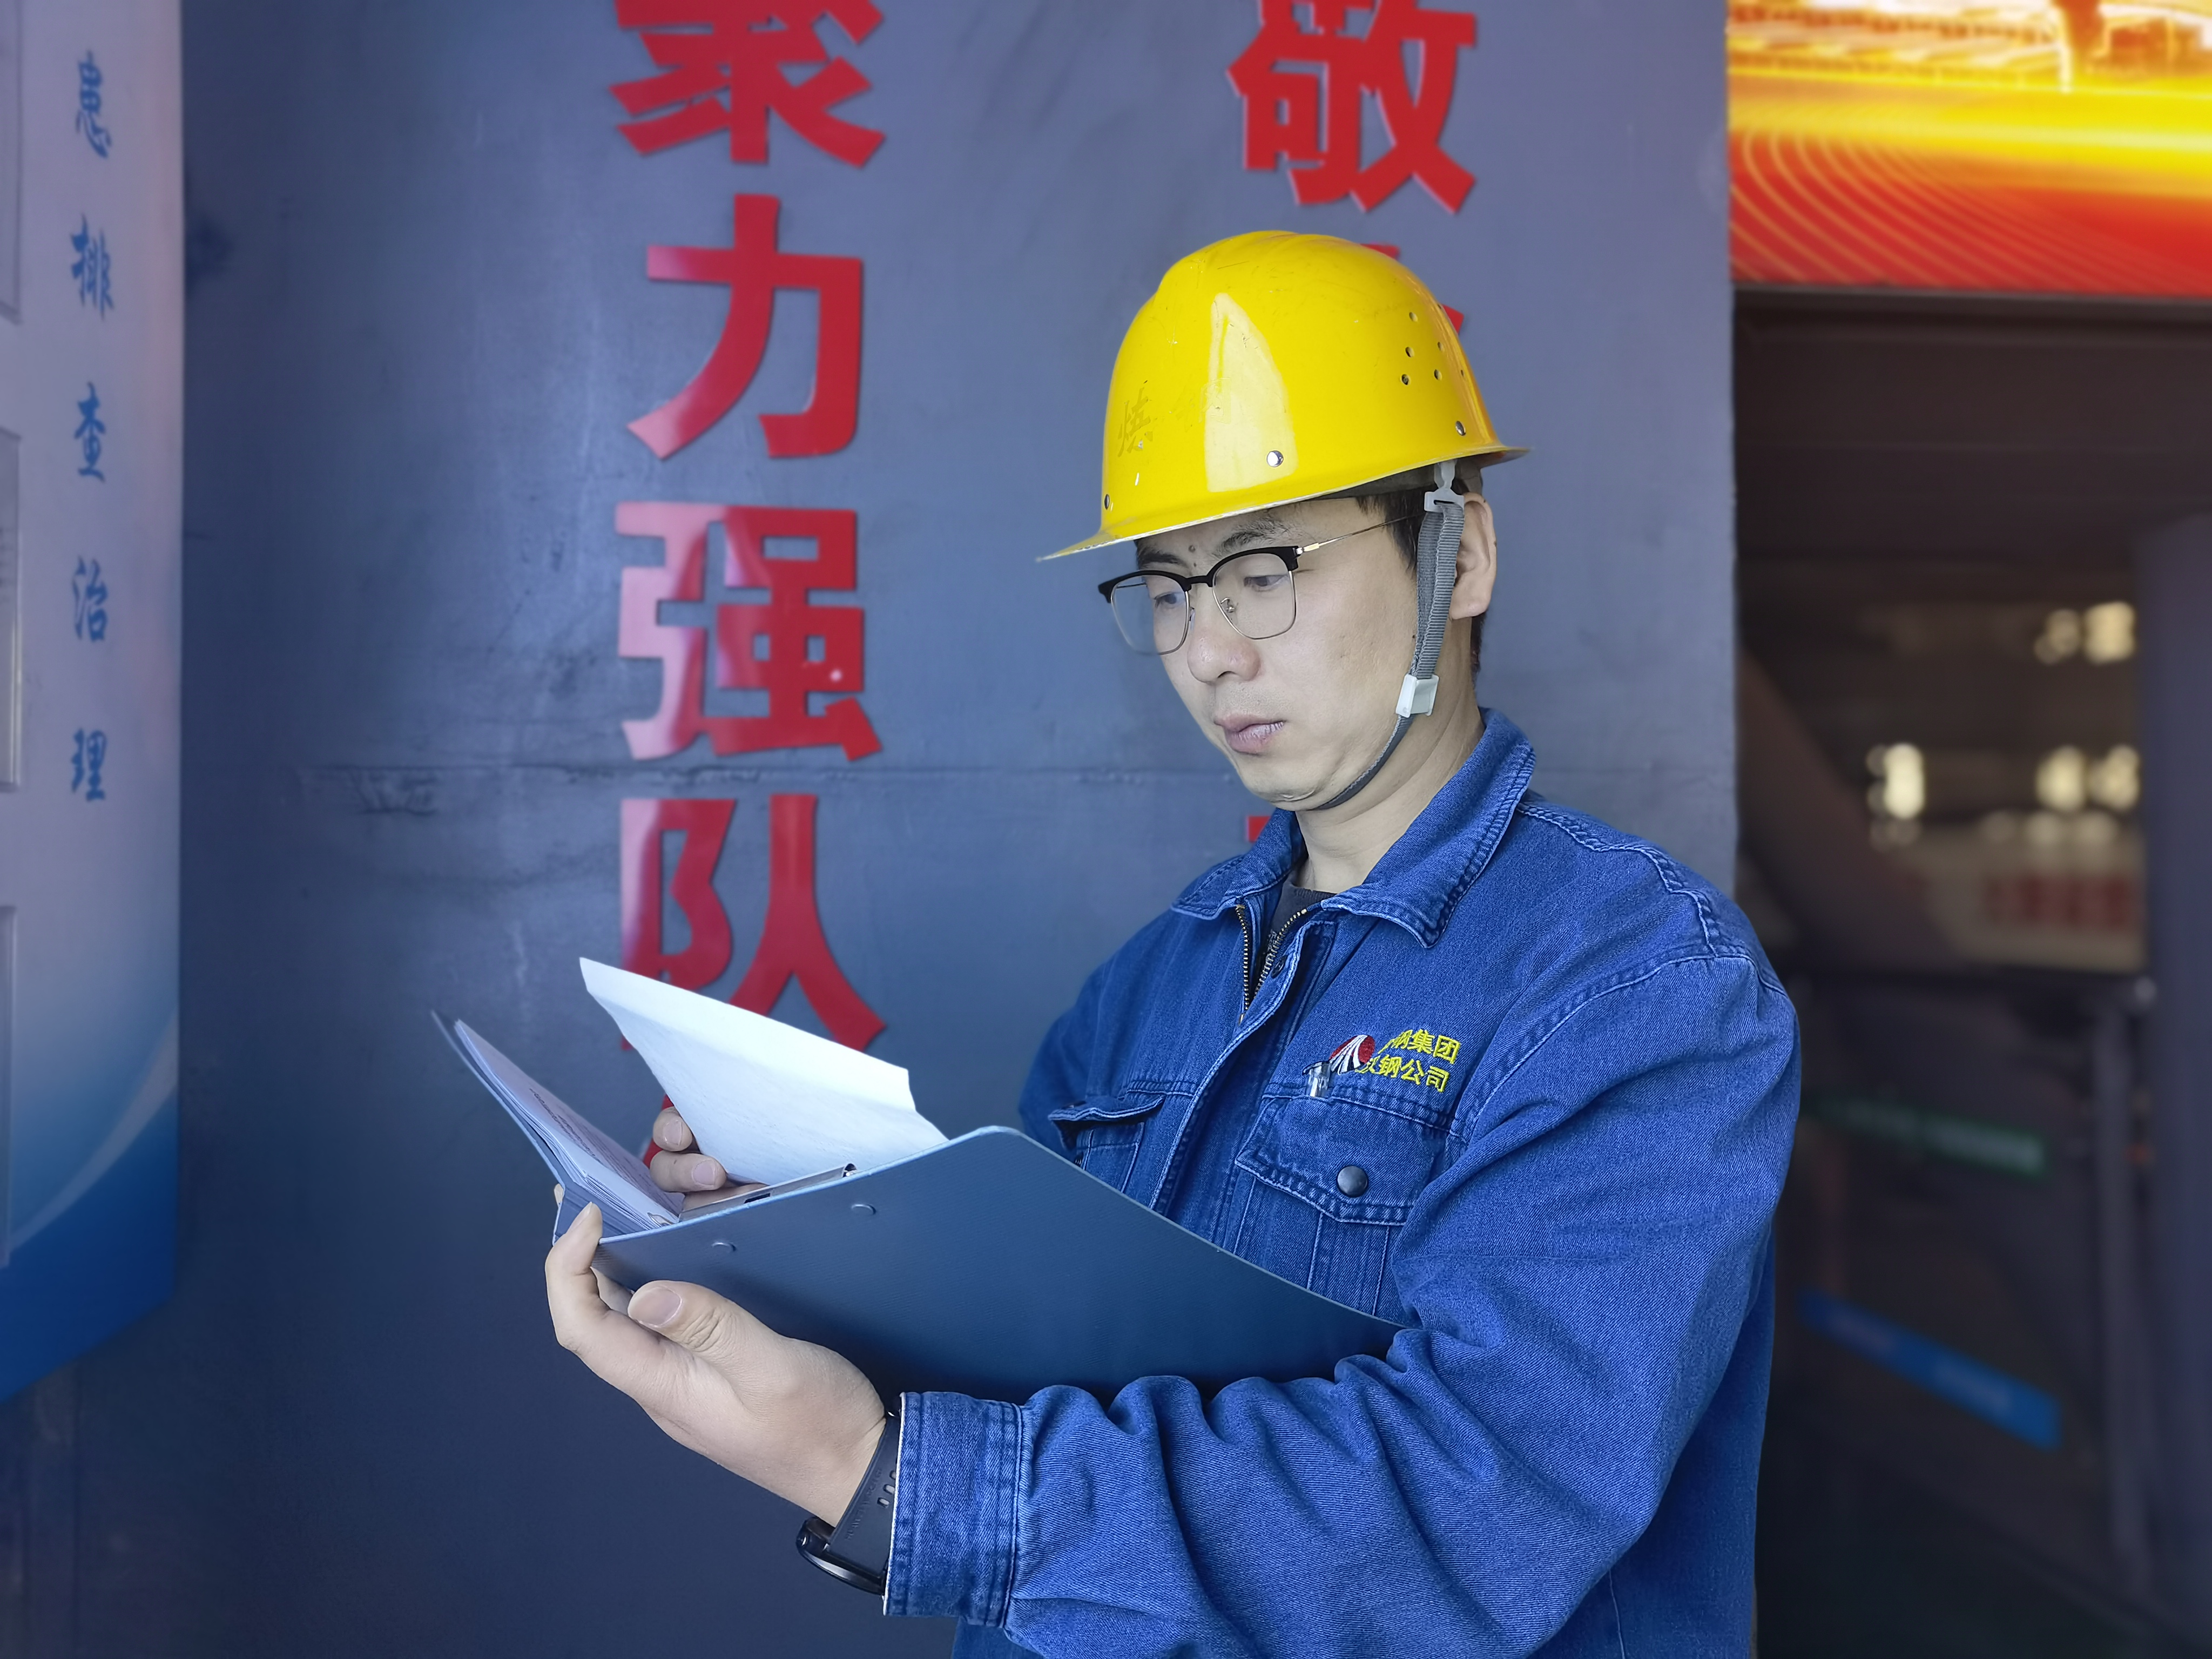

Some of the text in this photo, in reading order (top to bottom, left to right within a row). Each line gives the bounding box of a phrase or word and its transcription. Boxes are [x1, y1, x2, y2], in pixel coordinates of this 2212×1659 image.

[609, 0, 887, 1169] 聚力强队
[1377, 1029, 1461, 1064] 钢集团
